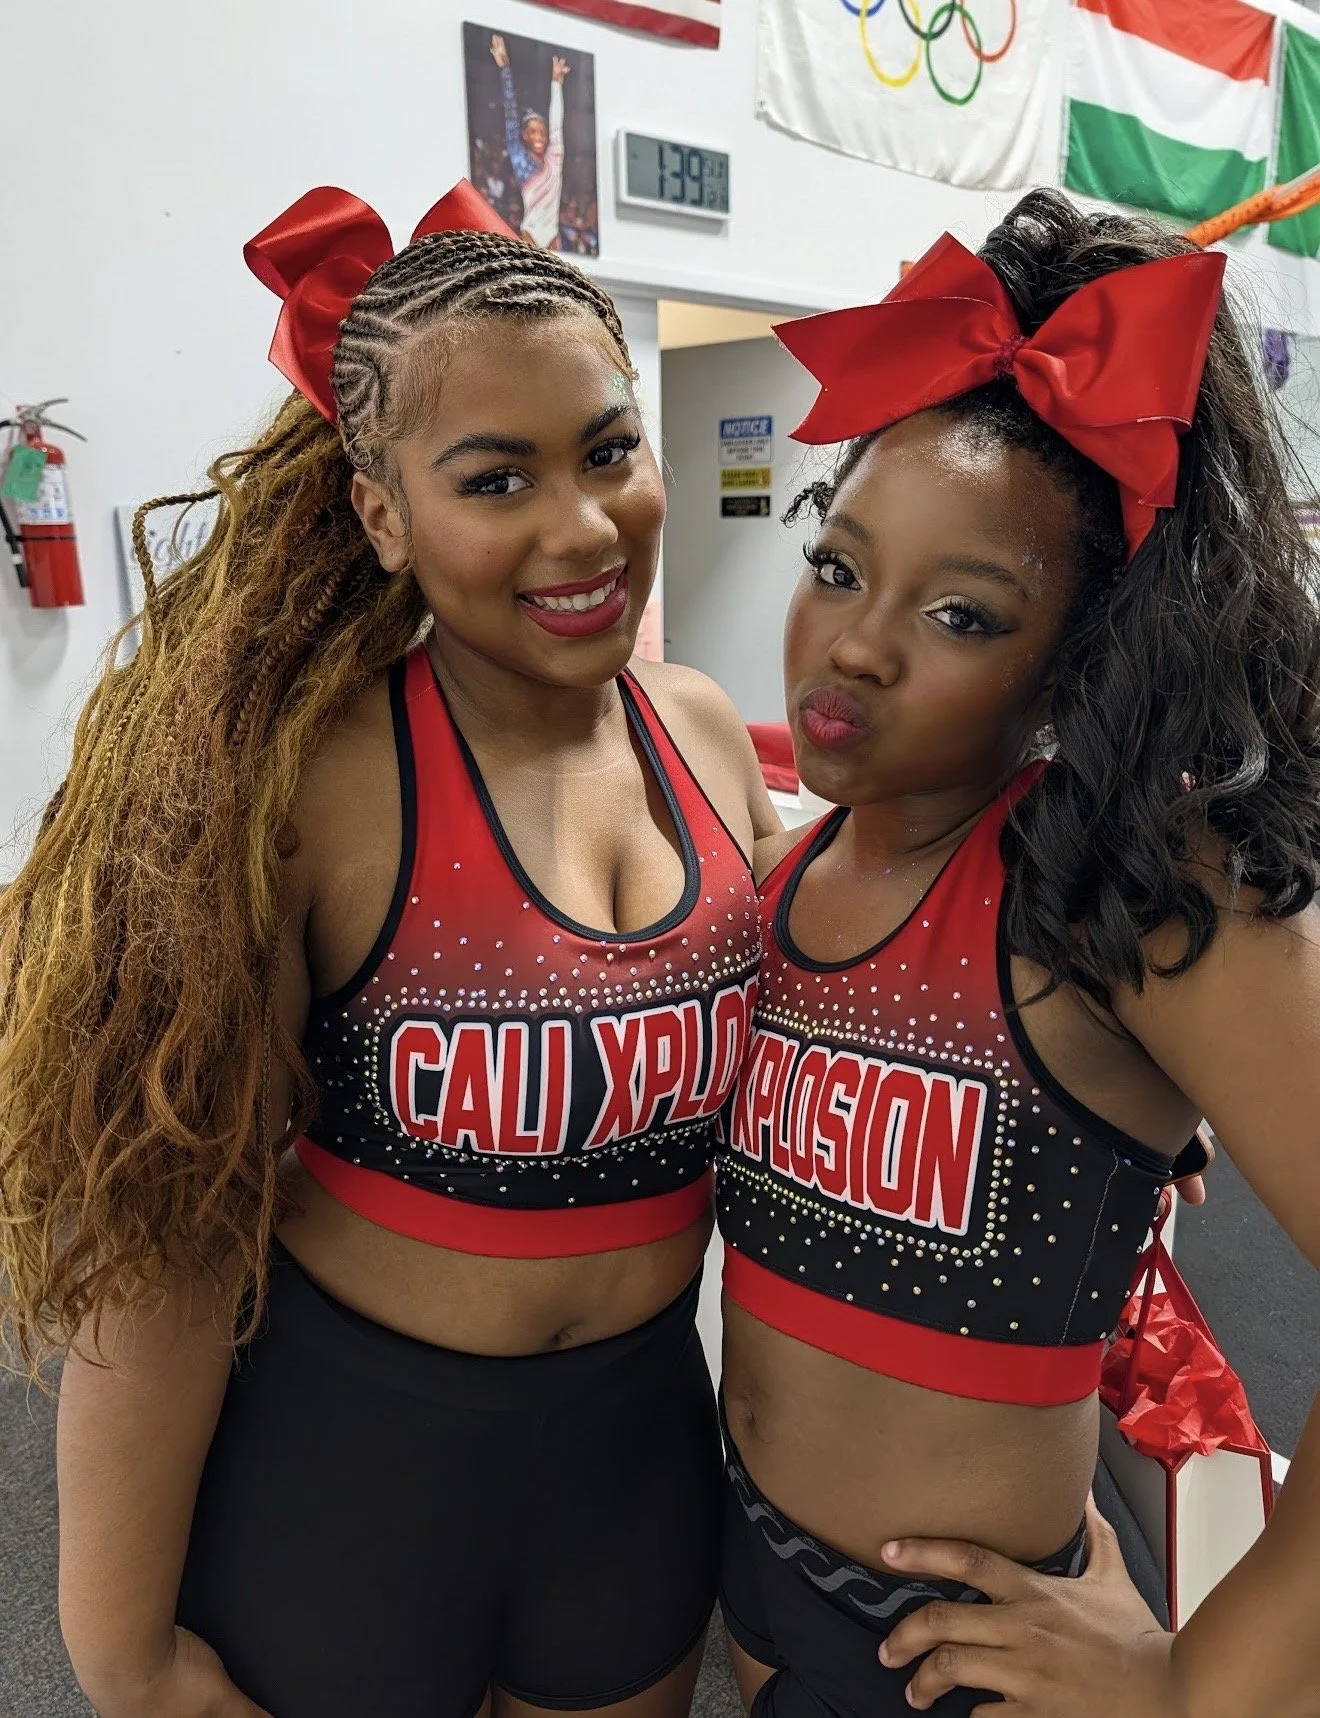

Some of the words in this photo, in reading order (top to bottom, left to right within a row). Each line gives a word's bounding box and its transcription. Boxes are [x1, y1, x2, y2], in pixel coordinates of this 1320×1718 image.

[723, 419, 769, 437] NOTICE
[391, 1020, 572, 1155] CALI
[731, 1029, 988, 1236] XPLOSION
